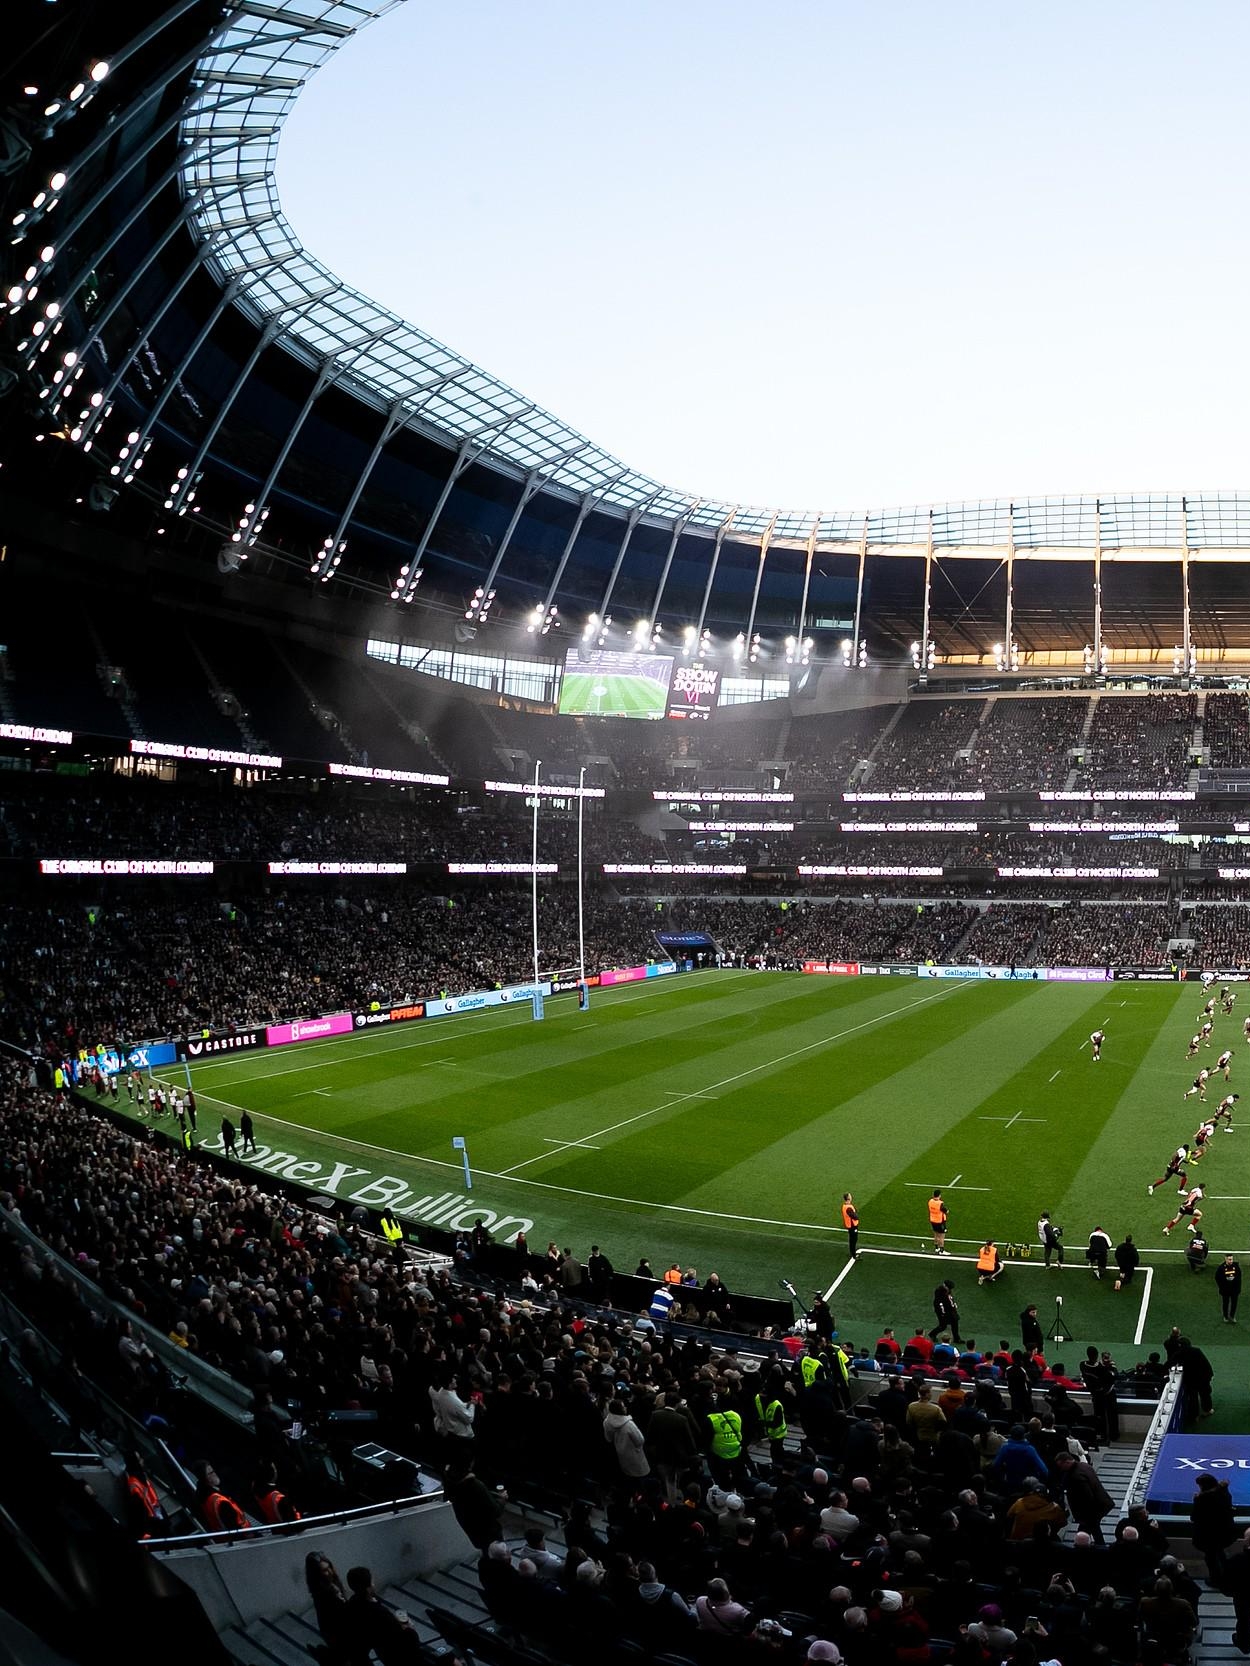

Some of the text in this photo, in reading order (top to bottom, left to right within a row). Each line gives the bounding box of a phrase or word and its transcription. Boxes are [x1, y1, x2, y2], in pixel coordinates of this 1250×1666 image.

[676, 668, 718, 682] SHOW
[673, 680, 716, 694] DOWN
[686, 692, 700, 703] VI
[945, 970, 978, 978] Gallagher
[458, 998, 484, 1008] Gallagher
[367, 1014, 390, 1023] Gallagher
[206, 1034, 256, 1052] CASTORE
[350, 1176, 535, 1245] Bullion
